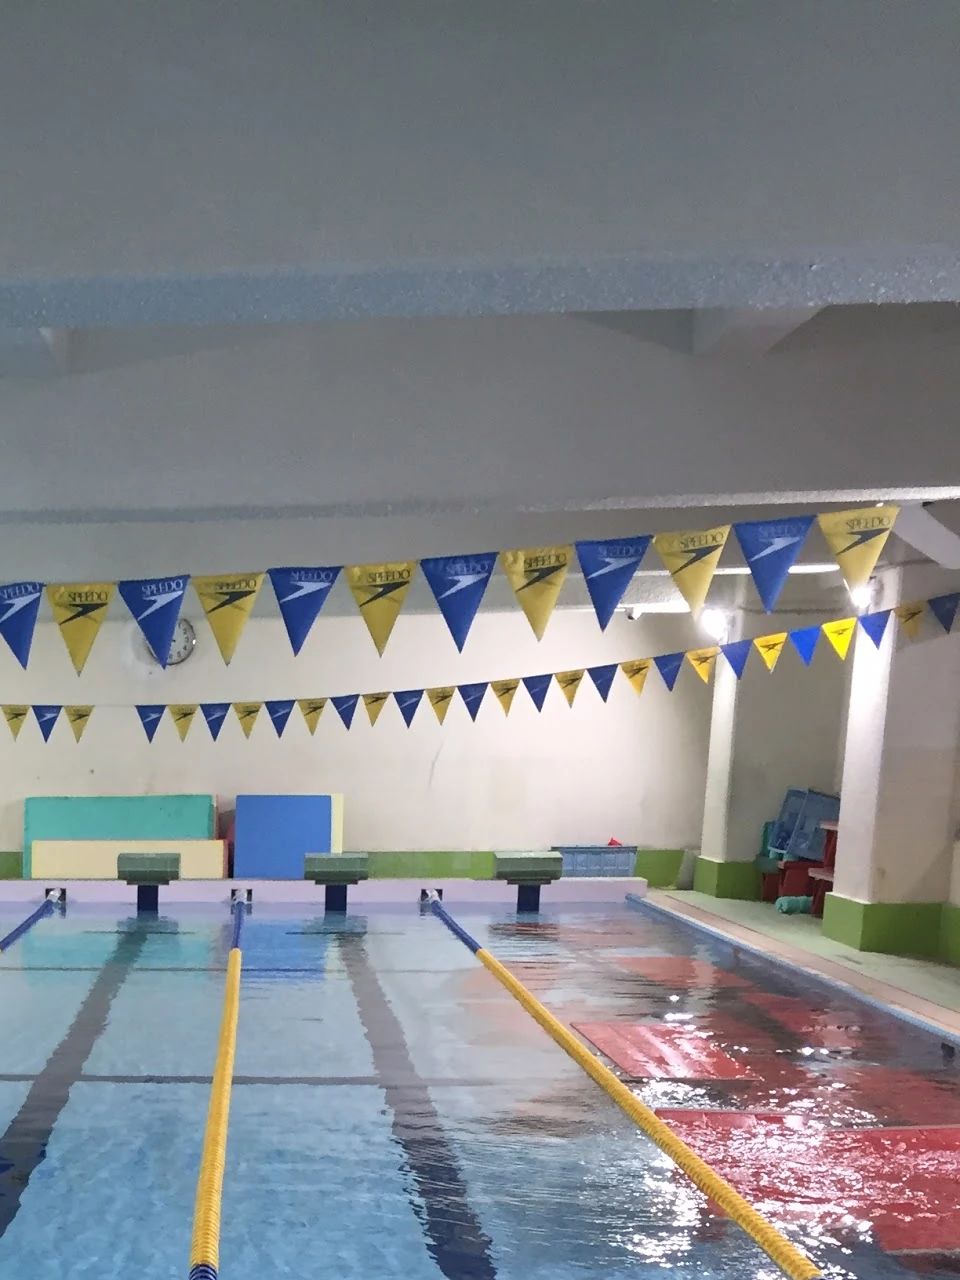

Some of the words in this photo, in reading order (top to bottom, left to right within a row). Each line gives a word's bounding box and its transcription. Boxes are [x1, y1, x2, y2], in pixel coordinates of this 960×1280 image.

[845, 516, 891, 530] SPEEDO
[680, 532, 723, 549] SPEEDO
[524, 553, 567, 569] SPEEDO
[368, 570, 411, 582] SPEEDO
[142, 579, 183, 595] SPEEDO
[215, 579, 257, 590] SPEEDO
[68, 591, 109, 601] SPEEDO
